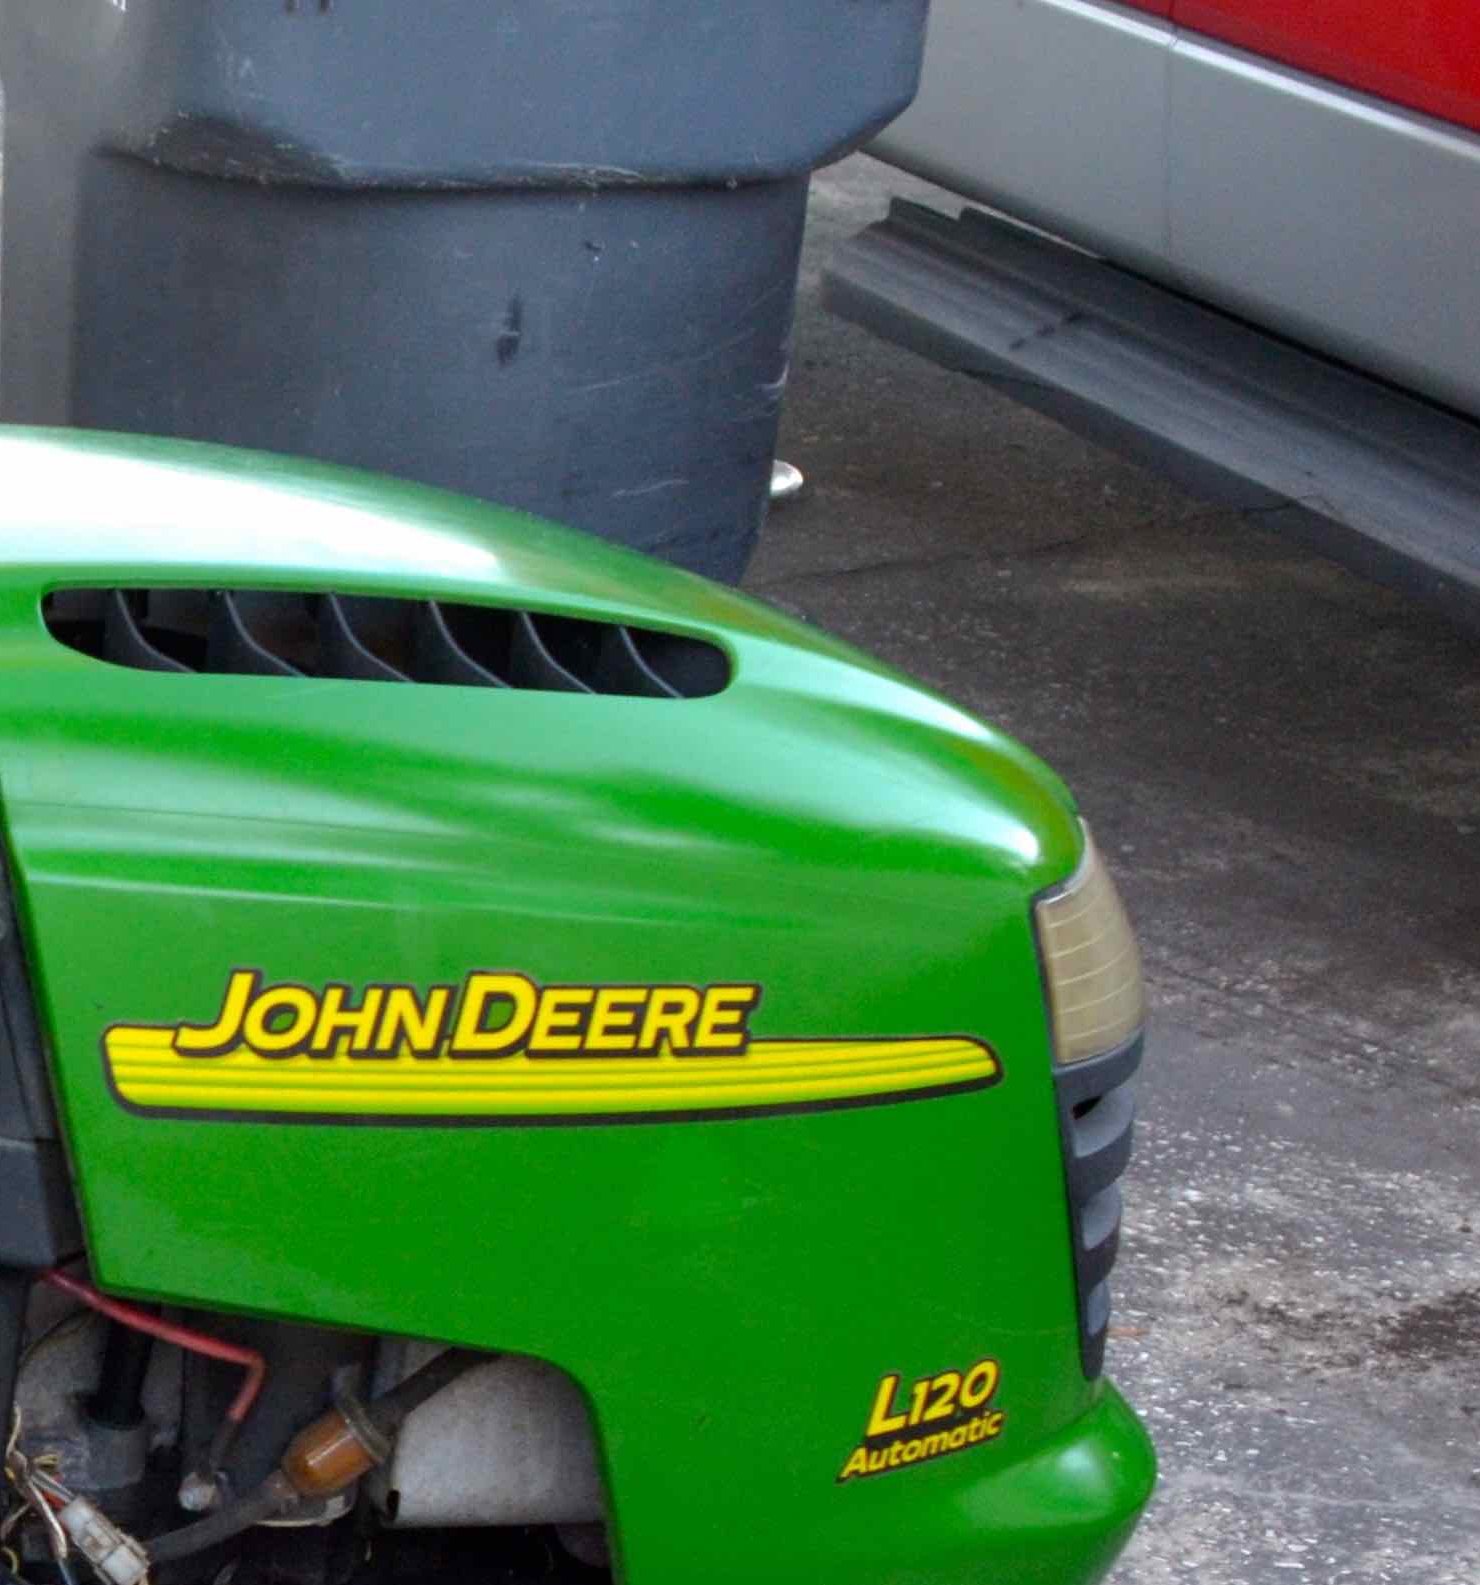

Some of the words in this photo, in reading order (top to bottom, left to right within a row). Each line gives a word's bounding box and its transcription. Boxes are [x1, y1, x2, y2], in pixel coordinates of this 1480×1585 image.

[173, 970, 449, 1054] JOHN
[452, 969, 757, 1055] DEERE
[865, 1358, 999, 1437] L120
[839, 1410, 1005, 1479] Automatic
